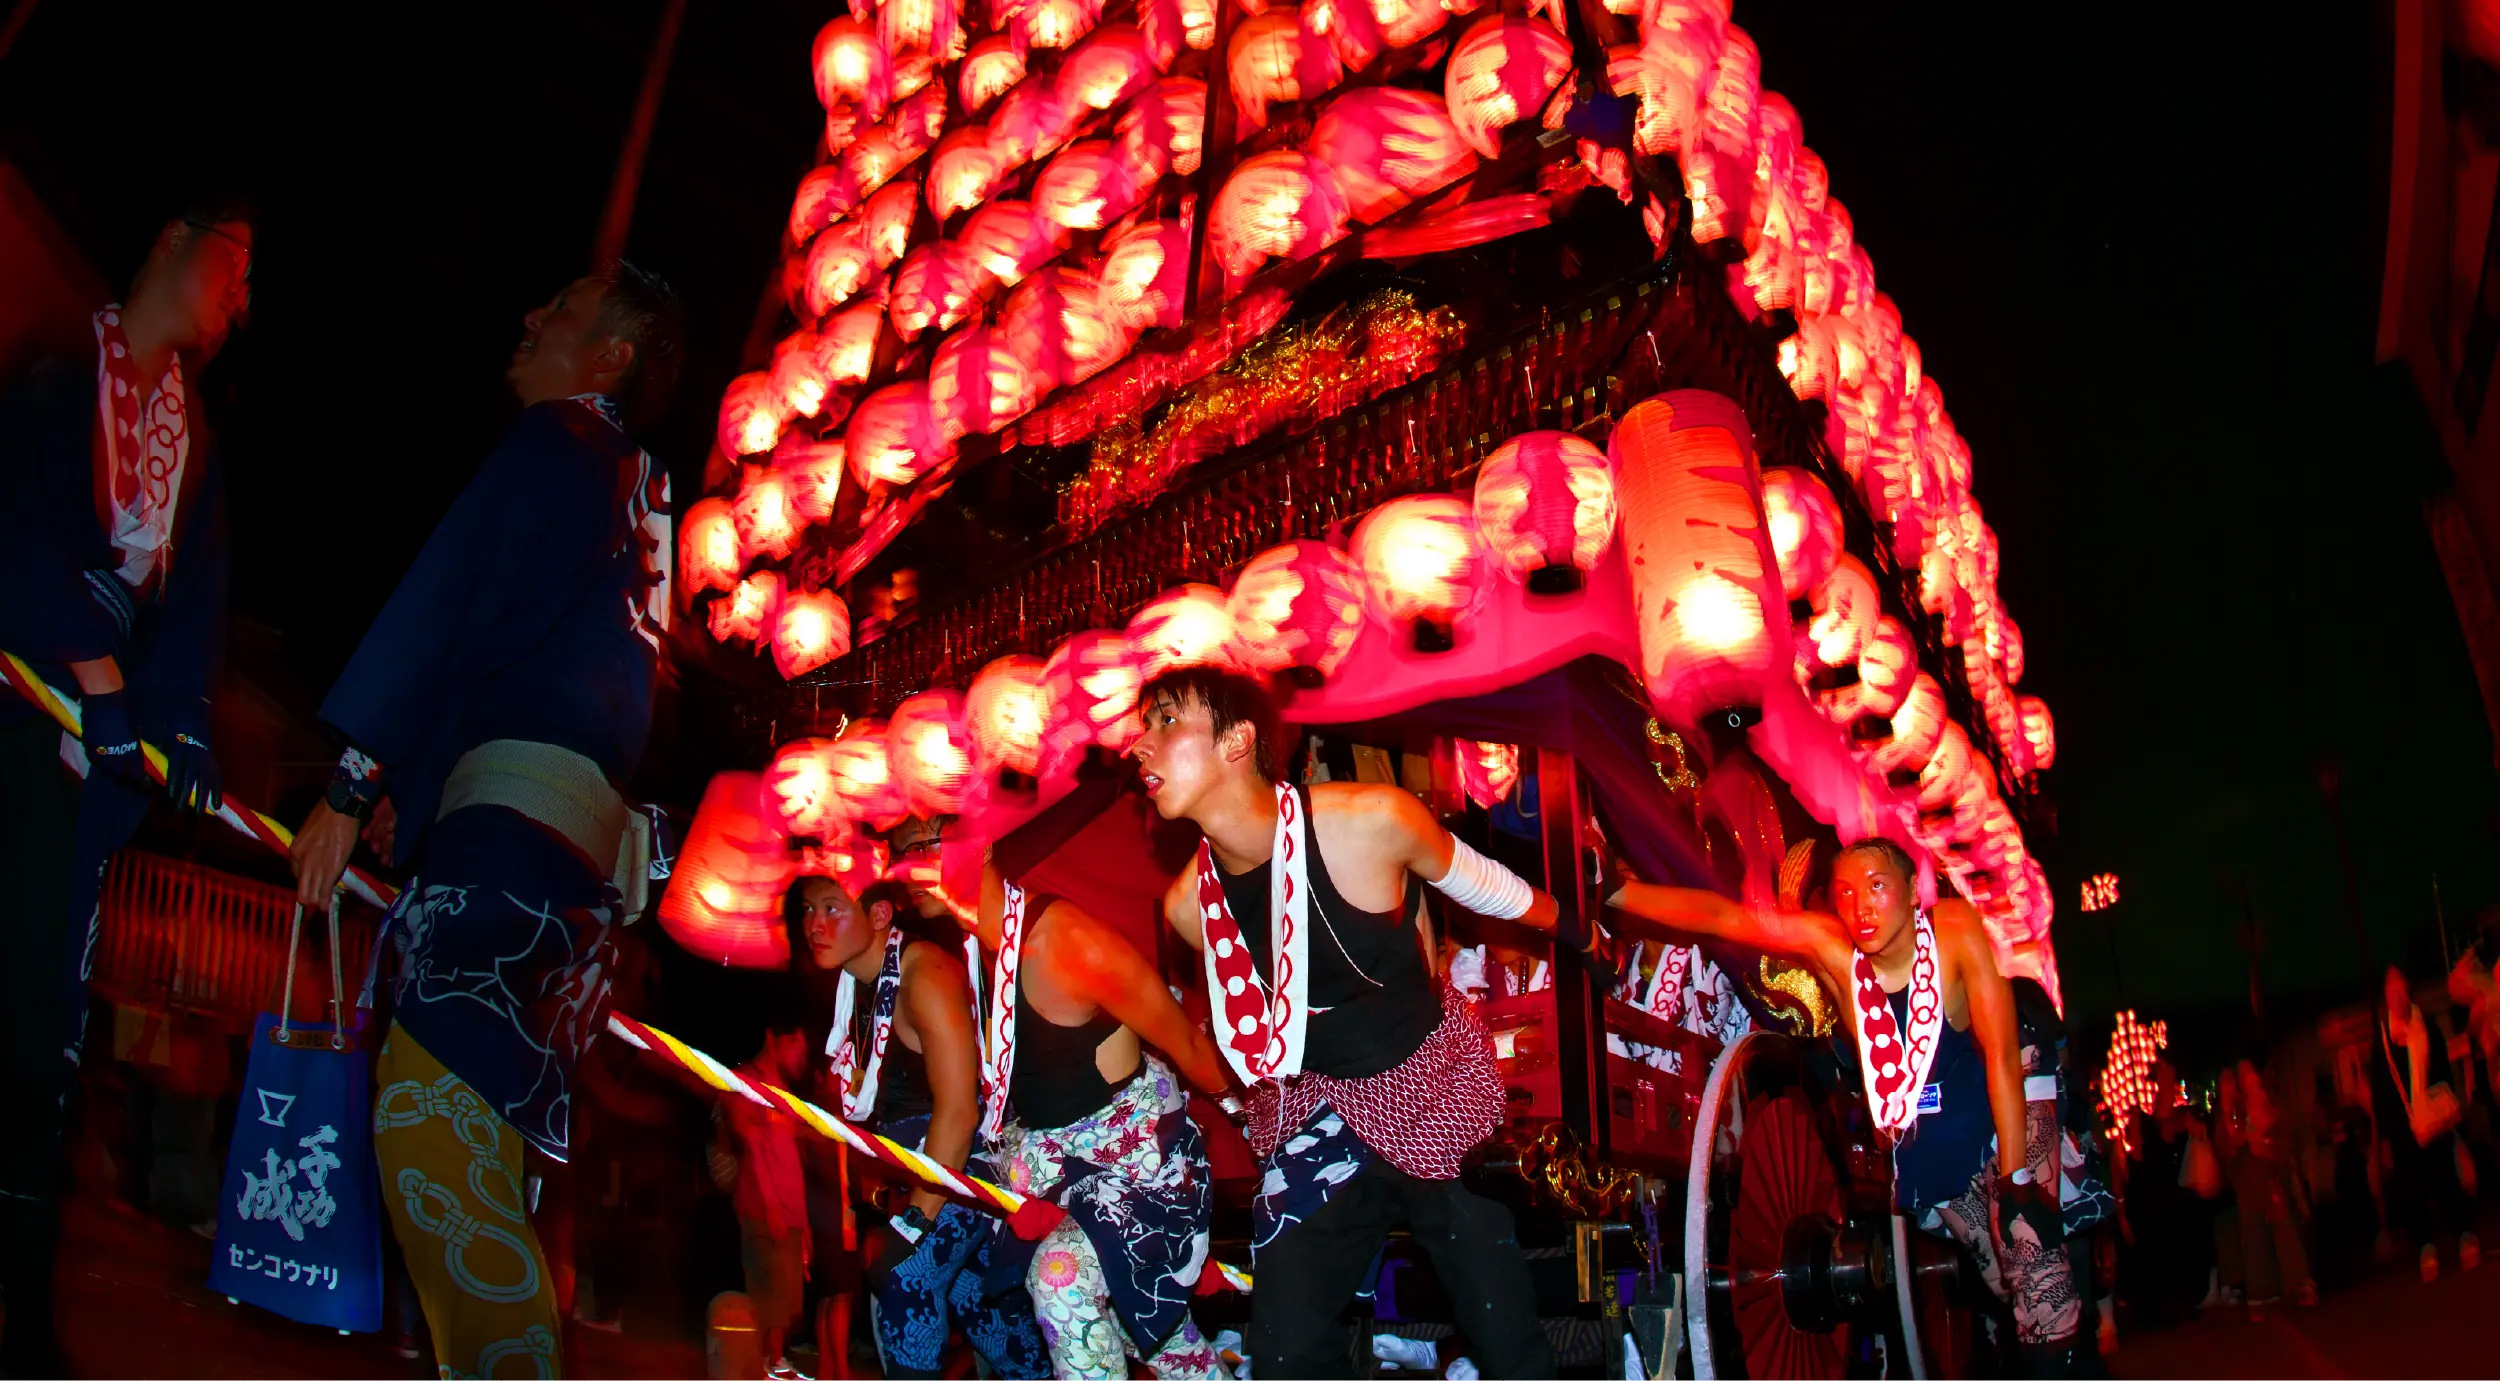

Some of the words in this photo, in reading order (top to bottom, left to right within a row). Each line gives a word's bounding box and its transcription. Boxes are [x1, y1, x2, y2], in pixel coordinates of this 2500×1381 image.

[229, 1243, 338, 1290] センコウナリ
